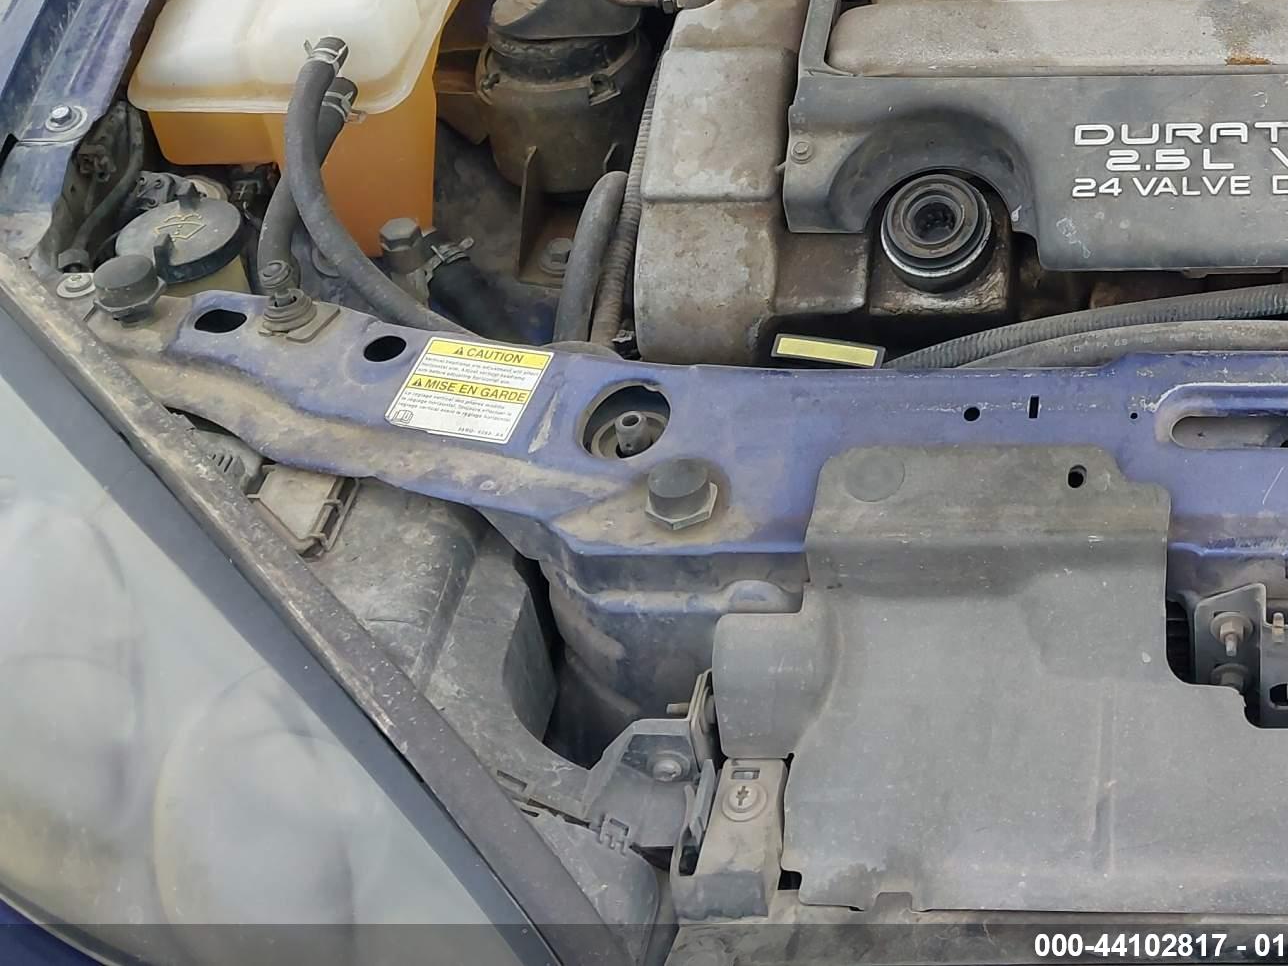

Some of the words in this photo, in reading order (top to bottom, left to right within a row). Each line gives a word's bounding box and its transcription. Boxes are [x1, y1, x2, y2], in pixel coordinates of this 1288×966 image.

[1071, 177, 1123, 198] 24
[1132, 175, 1251, 197] VALVE
[465, 347, 525, 363] CAUTION
[423, 378, 458, 392] MISE
[458, 384, 478, 395] EN
[478, 386, 527, 403] GARDE
